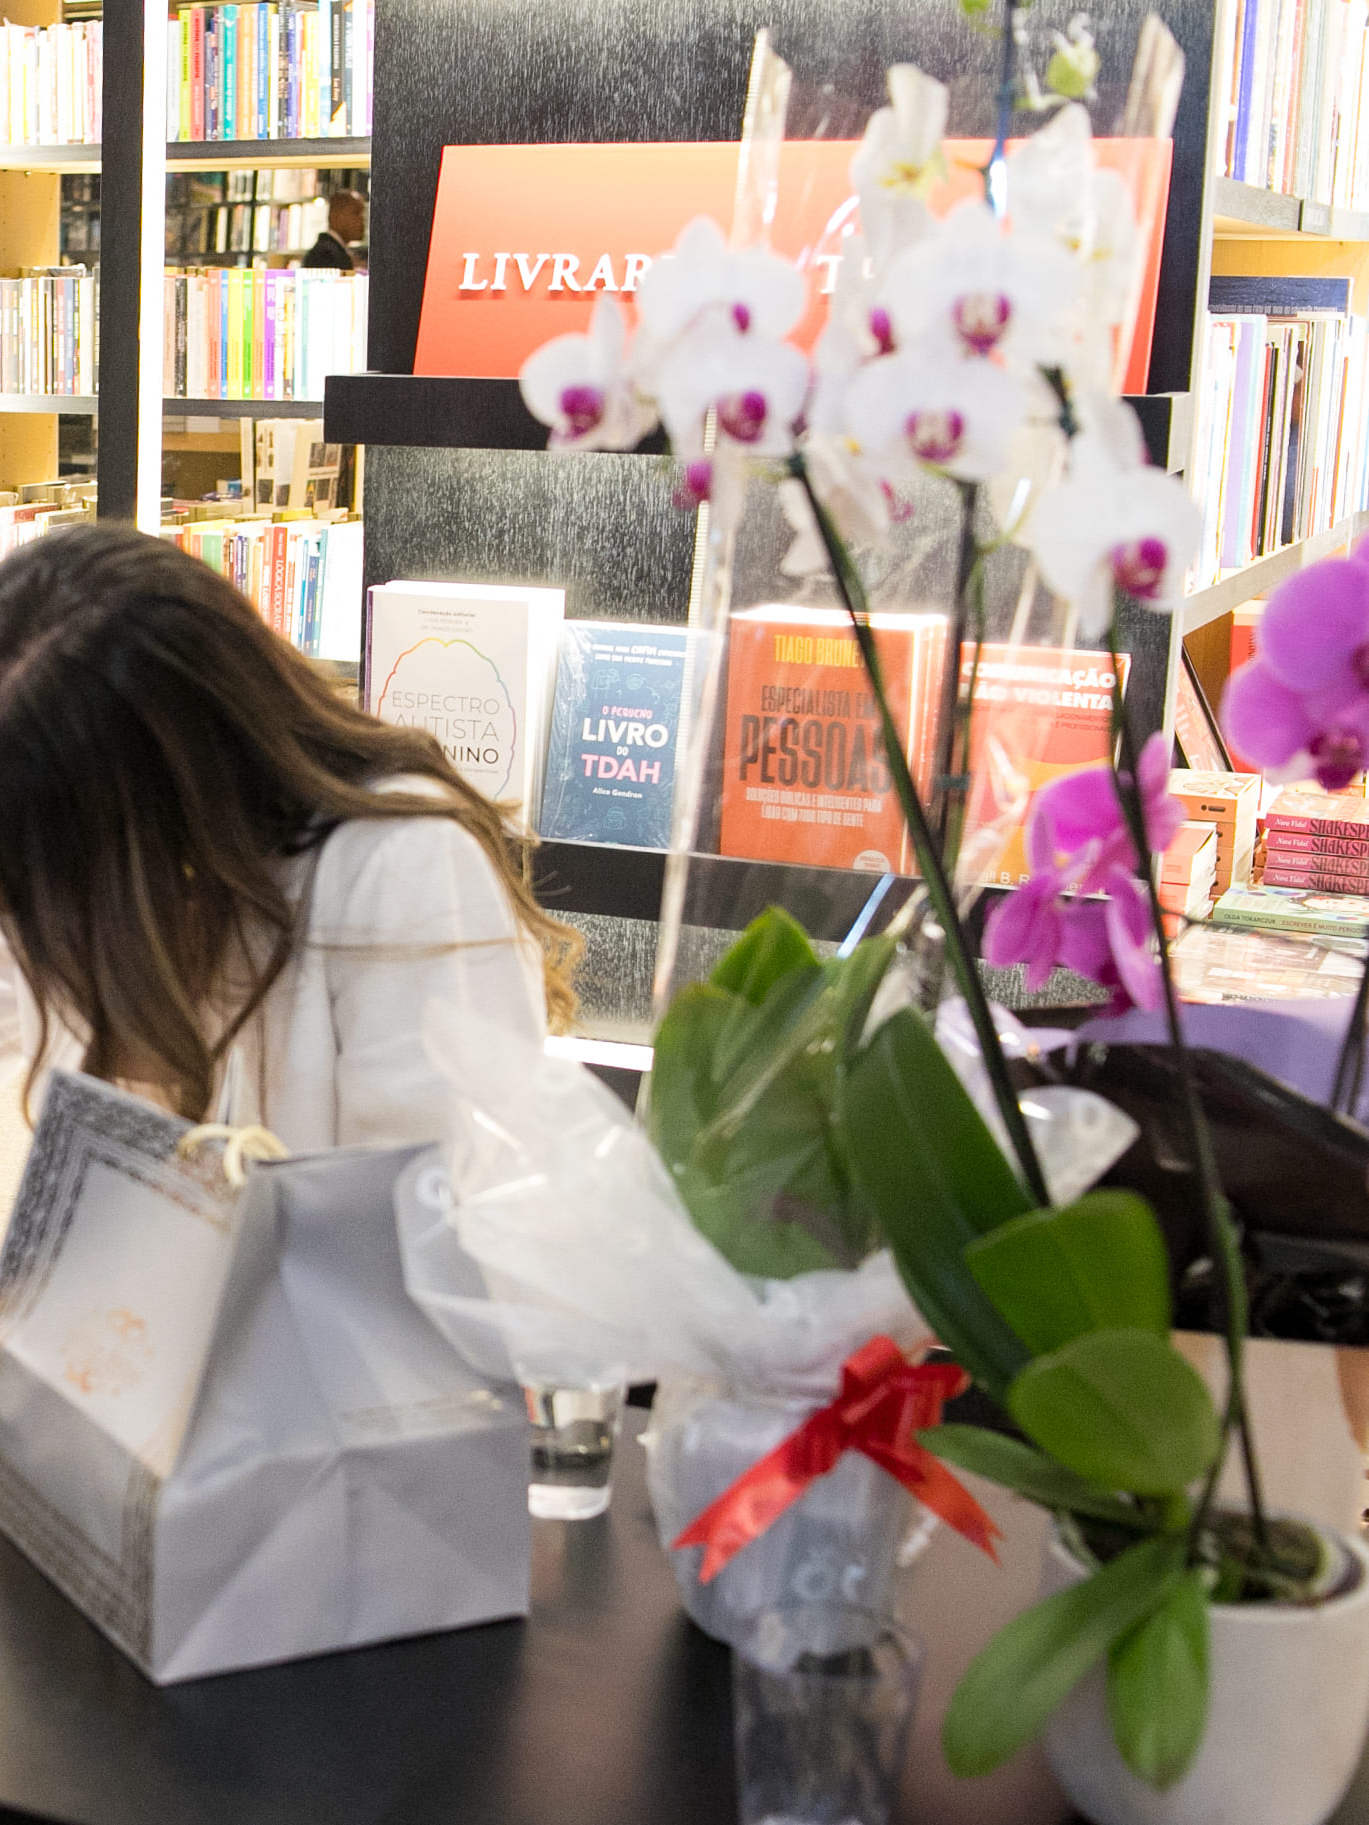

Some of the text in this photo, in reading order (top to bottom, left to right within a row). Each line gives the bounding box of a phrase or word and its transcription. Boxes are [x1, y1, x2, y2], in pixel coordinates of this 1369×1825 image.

[459, 252, 653, 292] LIVRAR
[273, 592, 283, 633] SOCRÁTIC
[775, 635, 864, 668] TIAGO BRUNE
[961, 662, 1116, 690] COMUNICAÇÃO
[392, 690, 500, 715] ESPECTRO
[611, 706, 653, 720] PEQUENO
[761, 685, 850, 718] ESPECIALISTA
[1015, 687, 1113, 710] VIOLENTA
[582, 717, 668, 748] LIVRO
[443, 745, 499, 764] NINO
[616, 746, 629, 756] DO
[739, 714, 891, 794] PESSOAS
[581, 754, 661, 784] TDAH
[593, 787, 610, 795] Alice
